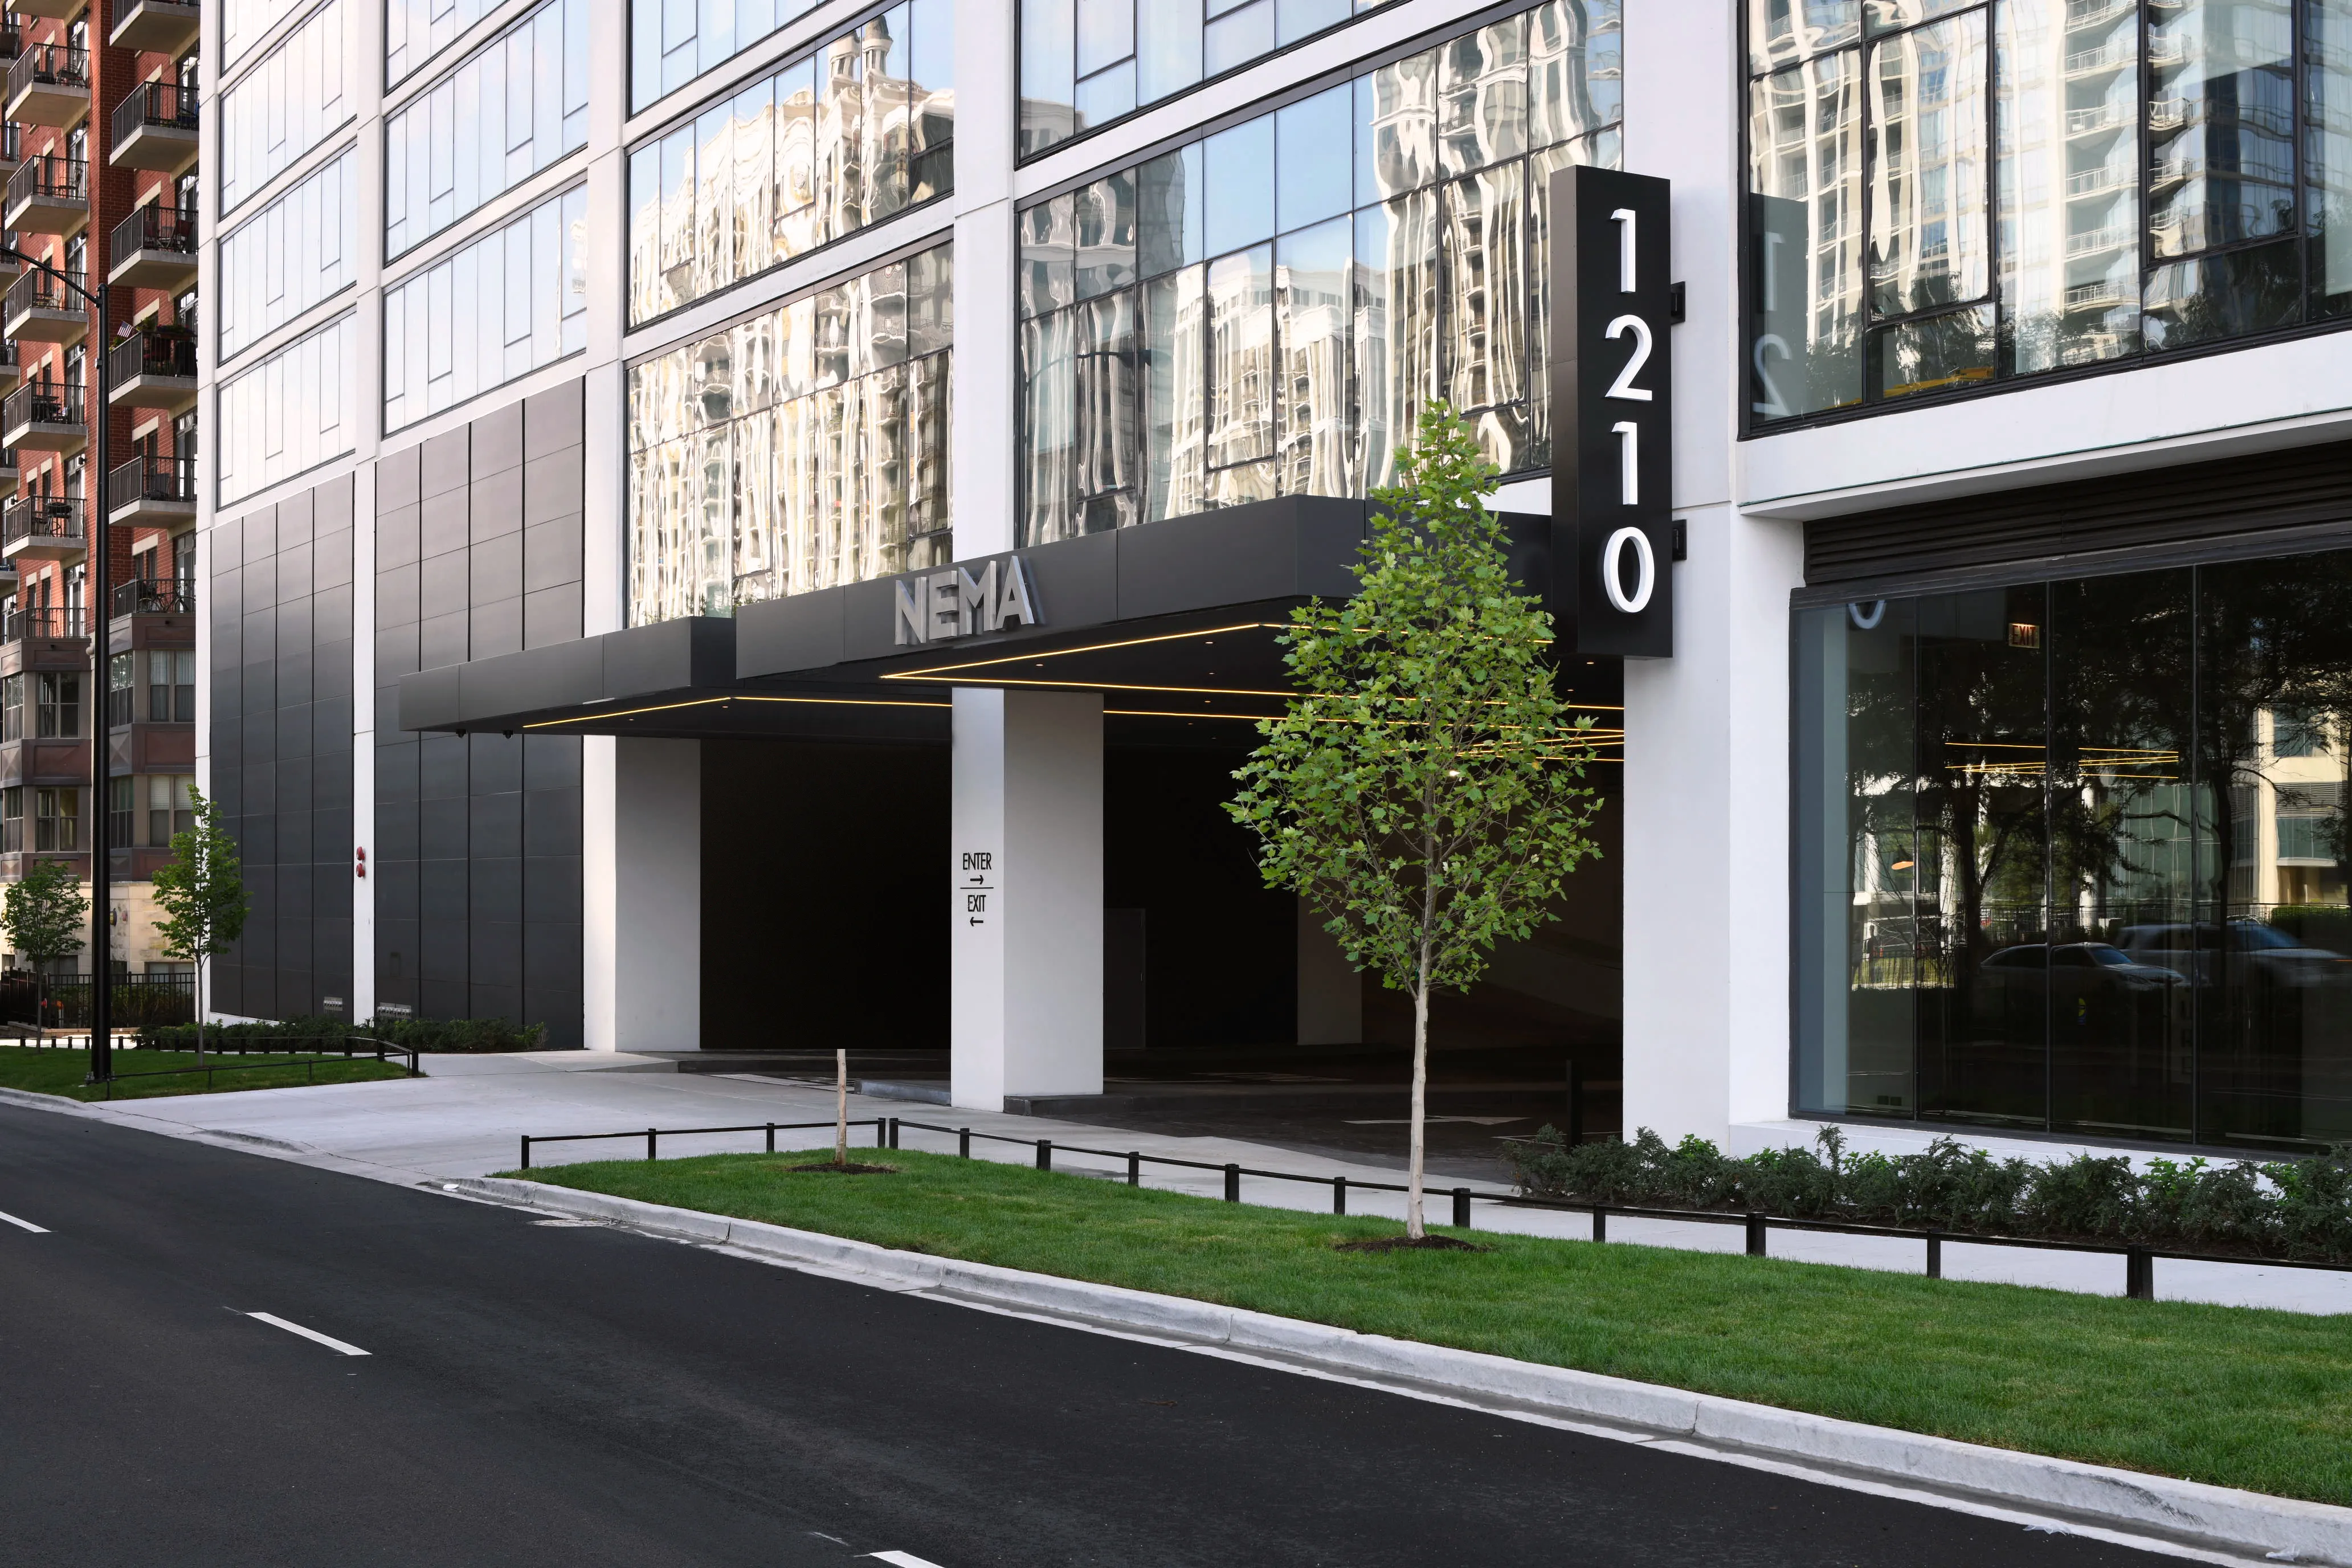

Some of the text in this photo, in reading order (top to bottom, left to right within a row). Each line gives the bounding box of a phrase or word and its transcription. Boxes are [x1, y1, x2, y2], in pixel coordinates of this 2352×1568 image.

[1603, 209, 1654, 613] 1210
[894, 556, 1035, 645] NEMA
[2012, 624, 2036, 647] EXIT
[963, 852, 991, 870] ENTER
[967, 895, 986, 912] EXIT
